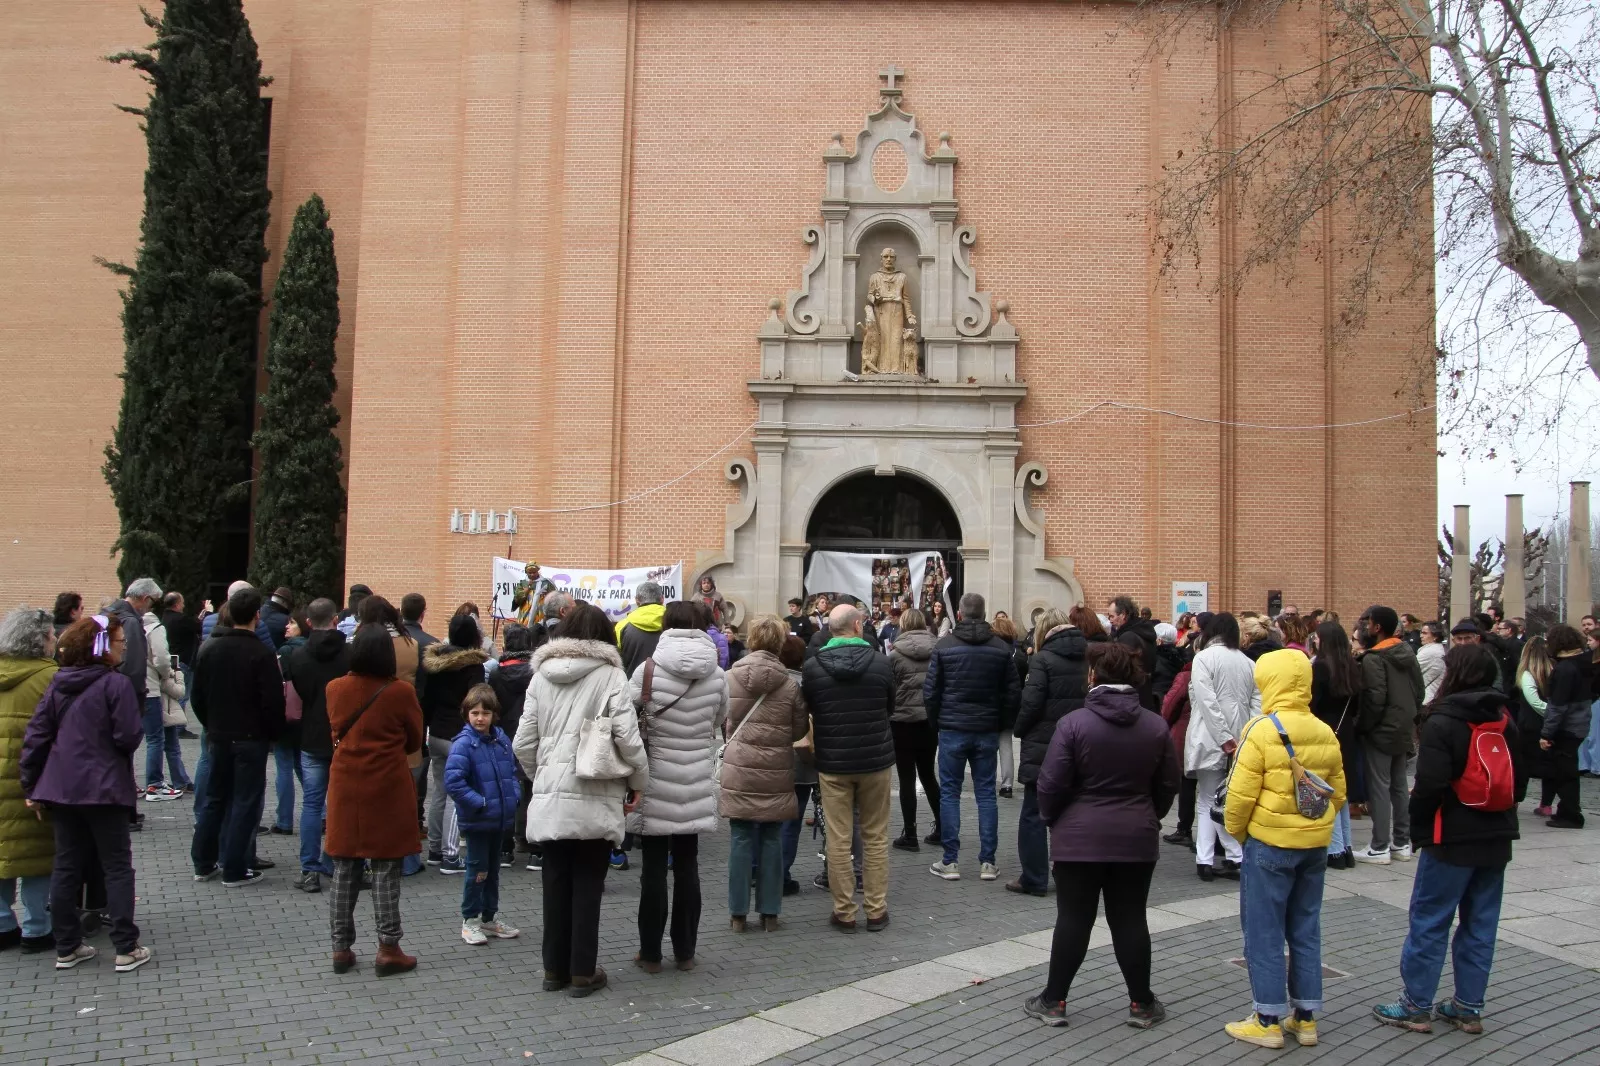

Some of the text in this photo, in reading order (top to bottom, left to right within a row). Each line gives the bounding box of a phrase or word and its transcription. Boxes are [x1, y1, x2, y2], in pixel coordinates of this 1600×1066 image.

[503, 582, 510, 595] SI
[598, 589, 606, 599] SE
[609, 589, 631, 600] PARA
[660, 585, 675, 599] NDO
